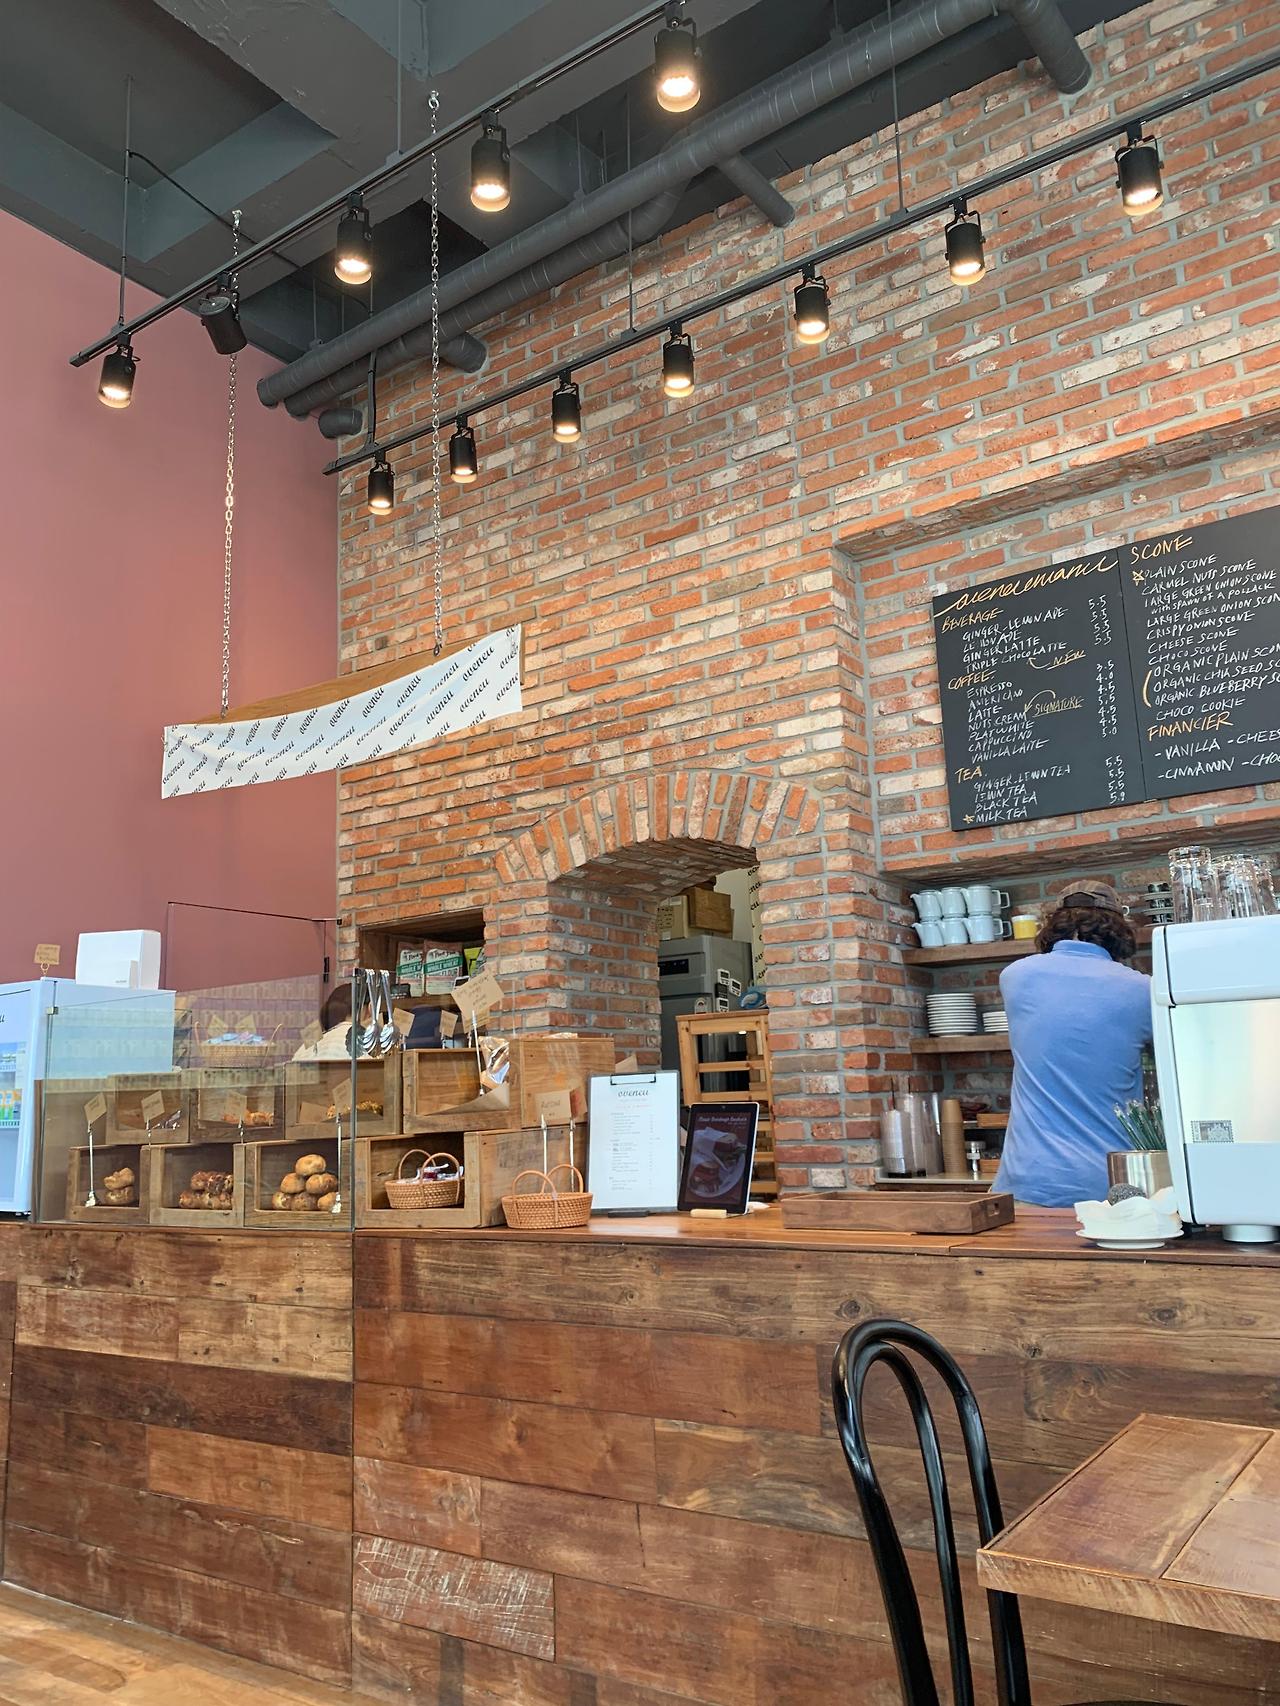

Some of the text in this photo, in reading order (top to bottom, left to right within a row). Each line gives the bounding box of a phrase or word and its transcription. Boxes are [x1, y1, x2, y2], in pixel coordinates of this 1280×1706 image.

[1131, 534, 1193, 564] SCONE
[1144, 554, 1218, 585] PLAIN SCONE
[1192, 569, 1218, 584] NUTS
[1220, 559, 1257, 576] SCONE
[1088, 594, 1107, 608] 5.5
[1144, 569, 1277, 607] LARGE GREEN ONION SCONE
[1216, 592, 1226, 600] A
[942, 608, 1004, 633] BEVERAGE
[1146, 612, 1181, 628] LARGE
[1184, 605, 1218, 622] GREEN
[1220, 598, 1252, 612] ONION
[1146, 610, 1255, 640] CRISPY ONION SCONE
[1148, 626, 1240, 654] CHEESE SCONE
[1148, 640, 1228, 666] CHOCO SCONE
[463, 646, 494, 682] oveneu
[965, 657, 998, 674] TRIPLE
[1154, 655, 1213, 678] ORGANIC
[1216, 648, 1250, 667] PLAIN
[967, 682, 1012, 698] ESPRESSO
[1096, 672, 1114, 683] 4.0
[1154, 673, 1200, 692] ORGANIC
[1204, 668, 1230, 680] CHIA
[1232, 662, 1262, 678] SEED
[460, 678, 490, 712] oveneu
[1155, 688, 1195, 706] ORGANIC
[1200, 675, 1268, 698] BLUEBERRY
[426, 690, 454, 724] oveneu
[968, 706, 1002, 722] LATTE
[1034, 696, 1084, 716] SIGNATURE
[1156, 698, 1246, 720] CHOCO COOKIE
[968, 717, 992, 732] NUTS
[994, 711, 1027, 726] CREAM
[996, 720, 1034, 734] WHITE
[1148, 711, 1234, 741] FINANCIER
[972, 746, 1010, 764] VANILLA
[1106, 755, 1123, 768] 5.5
[1008, 784, 1028, 798] TEA
[1108, 767, 1124, 779] 5.5
[974, 780, 1126, 814] BLACK TEA 5.5
[976, 811, 1005, 823] MILK
[1006, 806, 1028, 820] TEA
